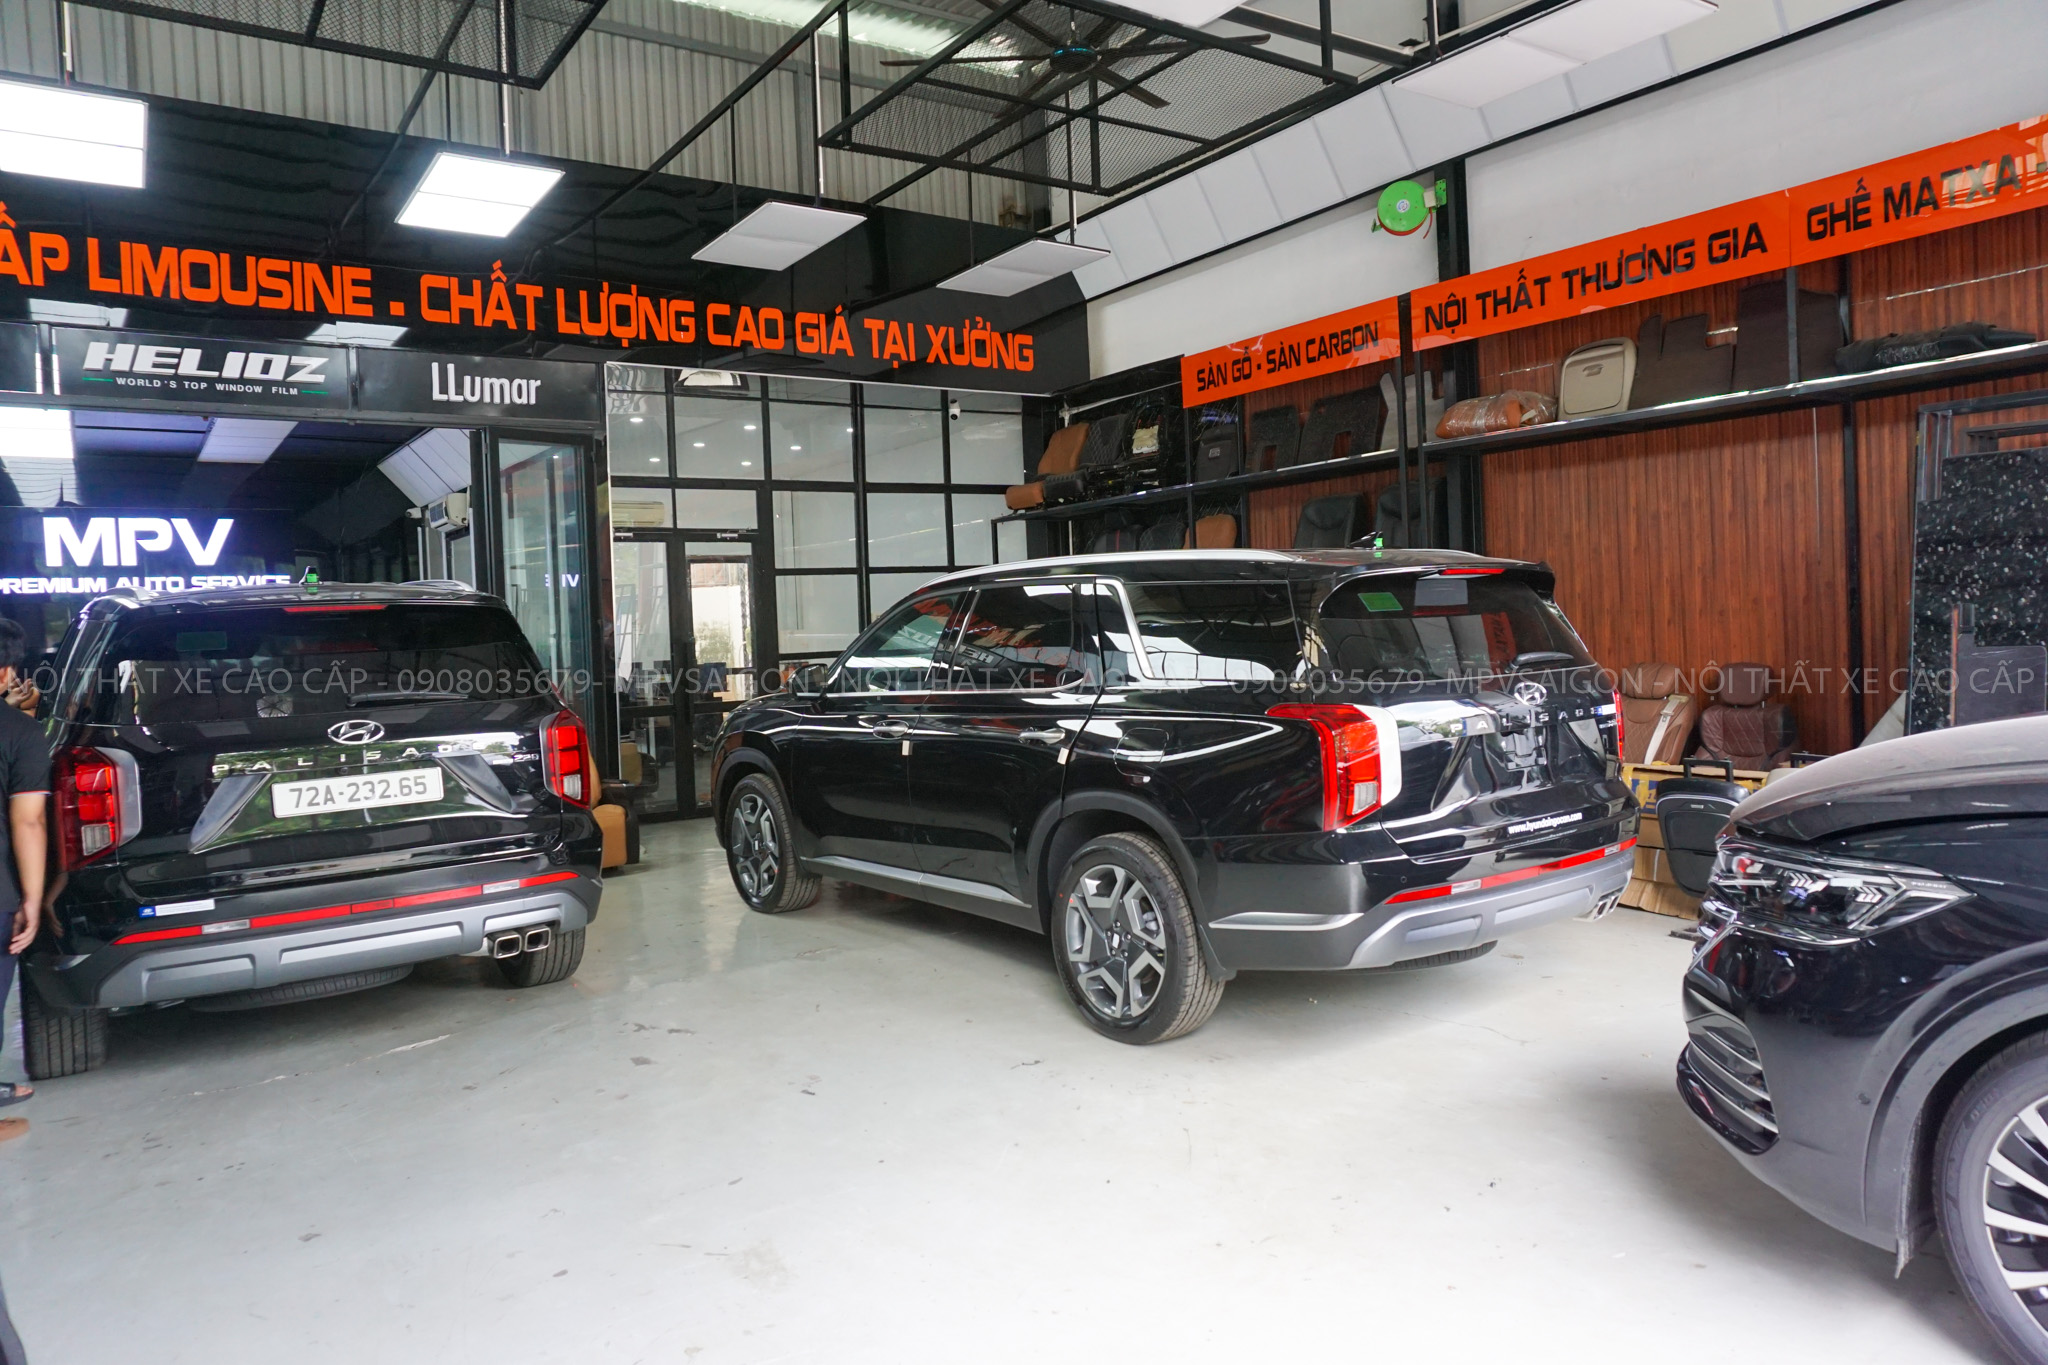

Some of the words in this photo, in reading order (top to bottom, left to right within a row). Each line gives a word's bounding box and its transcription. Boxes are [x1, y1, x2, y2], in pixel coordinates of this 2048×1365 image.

[1807, 176, 1872, 241] GHẾ
[1883, 154, 2022, 223] MATXA
[1425, 293, 1467, 333] NỘI
[1476, 268, 1551, 320] THẤT
[1562, 239, 1695, 300] THƯƠNG
[1708, 222, 1768, 265] GIA
[87, 237, 374, 317] LIMOUSINE
[420, 259, 543, 331] CHẤT
[556, 281, 696, 347] LƯỢNG
[706, 303, 785, 350] CAO
[795, 304, 854, 357] GIÁ
[864, 318, 916, 368] TẠI
[925, 316, 1034, 372] XƯỞNG
[83, 341, 329, 384] HELIOZ
[1197, 361, 1228, 392] SÀN
[1266, 341, 1301, 374] SÀN
[1305, 321, 1379, 364] CARBON
[183, 381, 208, 390] TOP
[215, 382, 263, 394] WINDOW
[271, 386, 298, 396] FILM
[431, 362, 541, 405] LLumar
[43, 517, 234, 567] MPV
[289, 775, 427, 810] 72A-232.65
